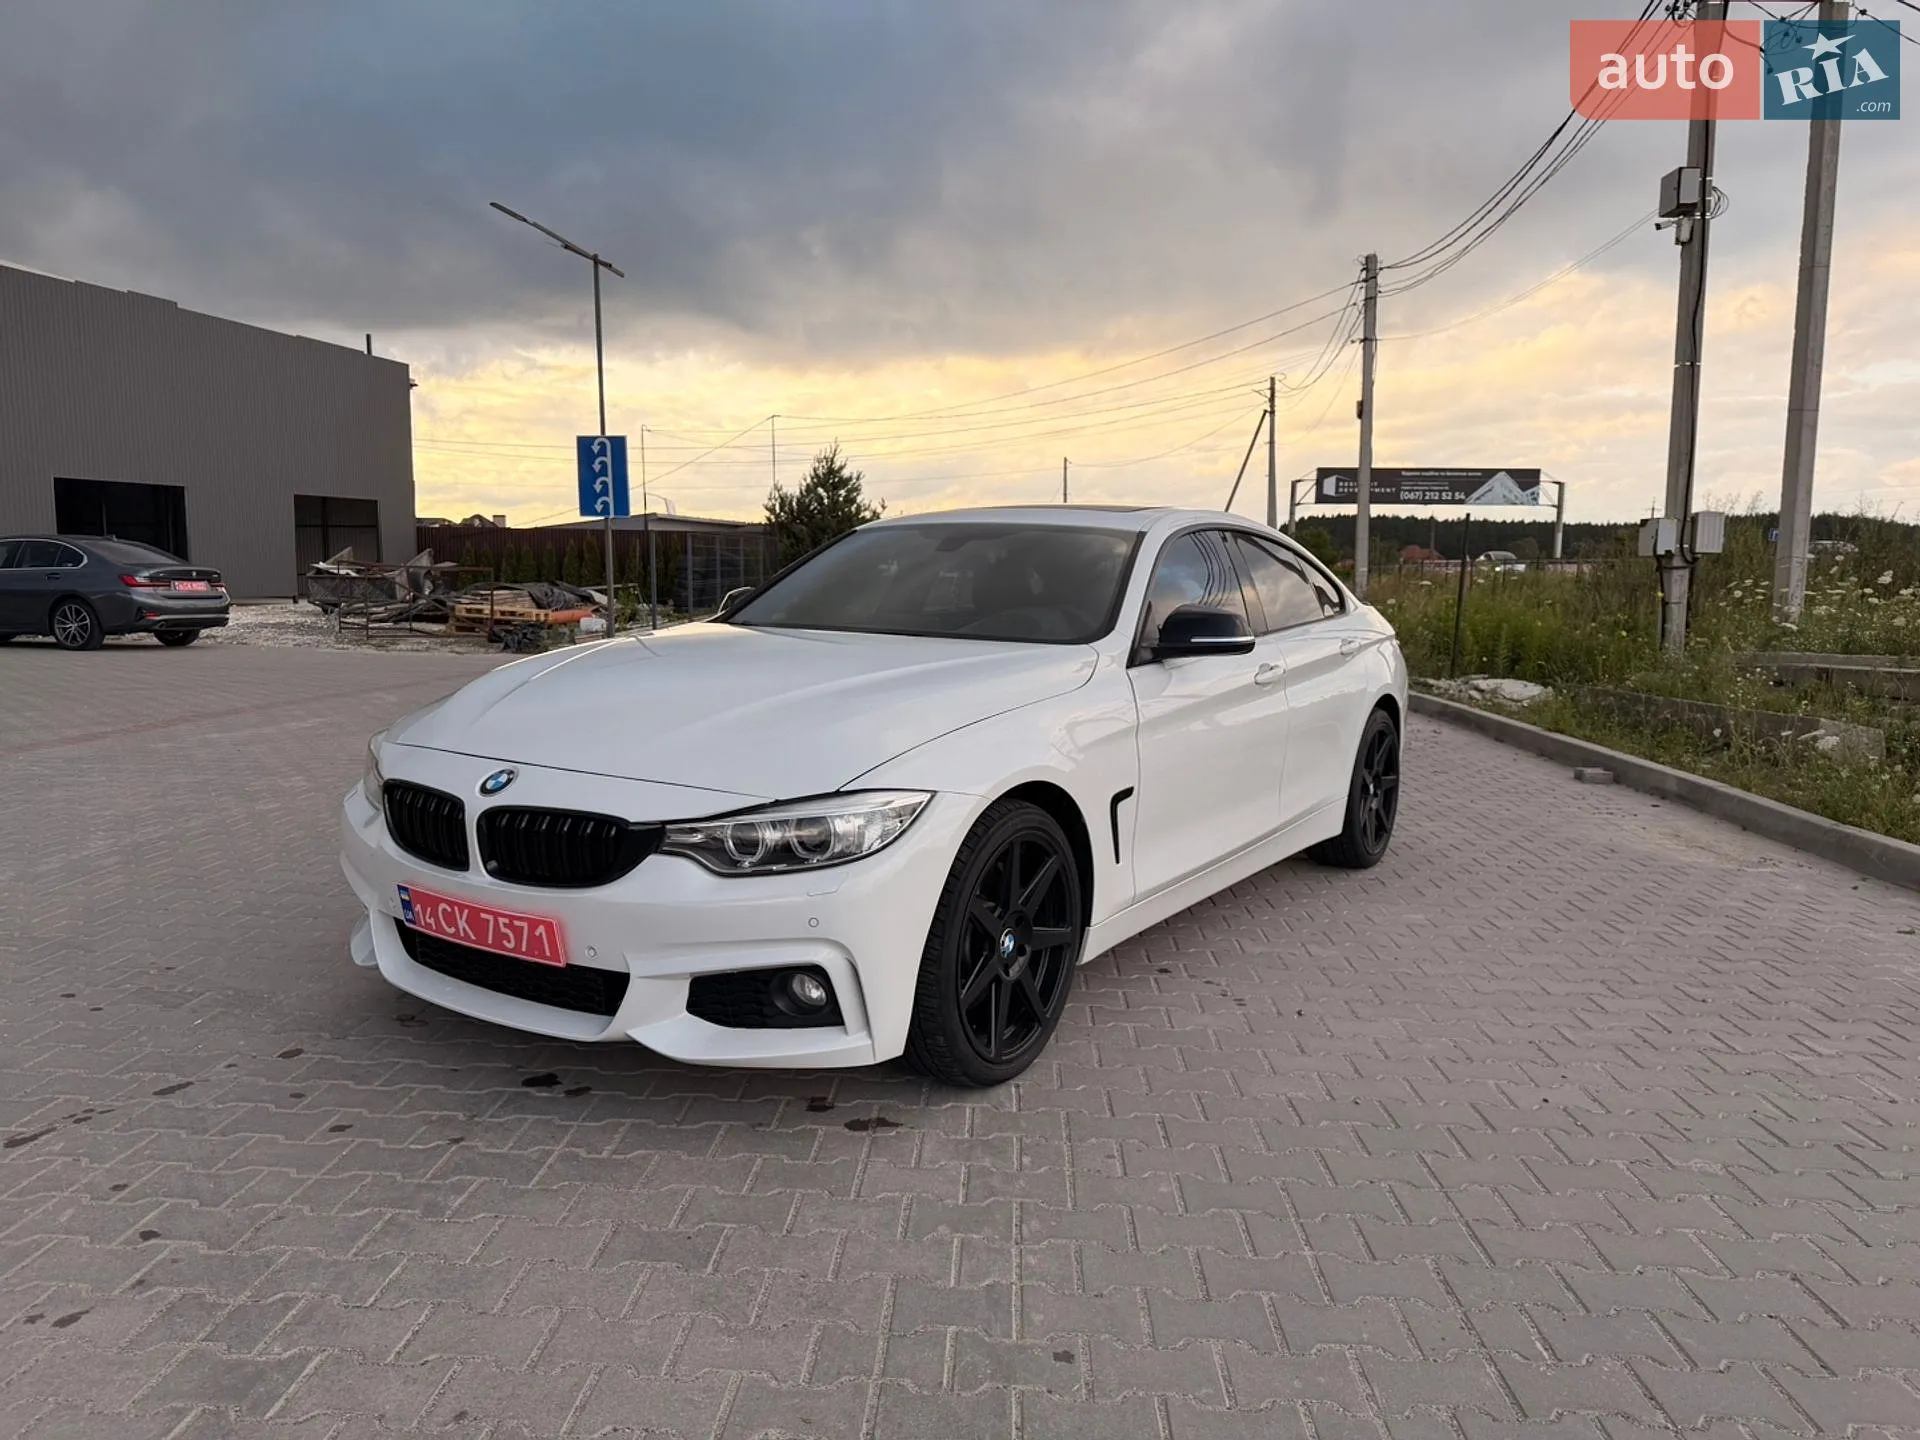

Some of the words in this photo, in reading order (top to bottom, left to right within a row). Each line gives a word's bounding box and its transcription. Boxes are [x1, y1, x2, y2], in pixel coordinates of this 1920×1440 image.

[1400, 490, 1423, 500] (067)
[1424, 491, 1440, 500] 212
[1441, 491, 1453, 500] 52
[480, 912, 550, 957] 7571
